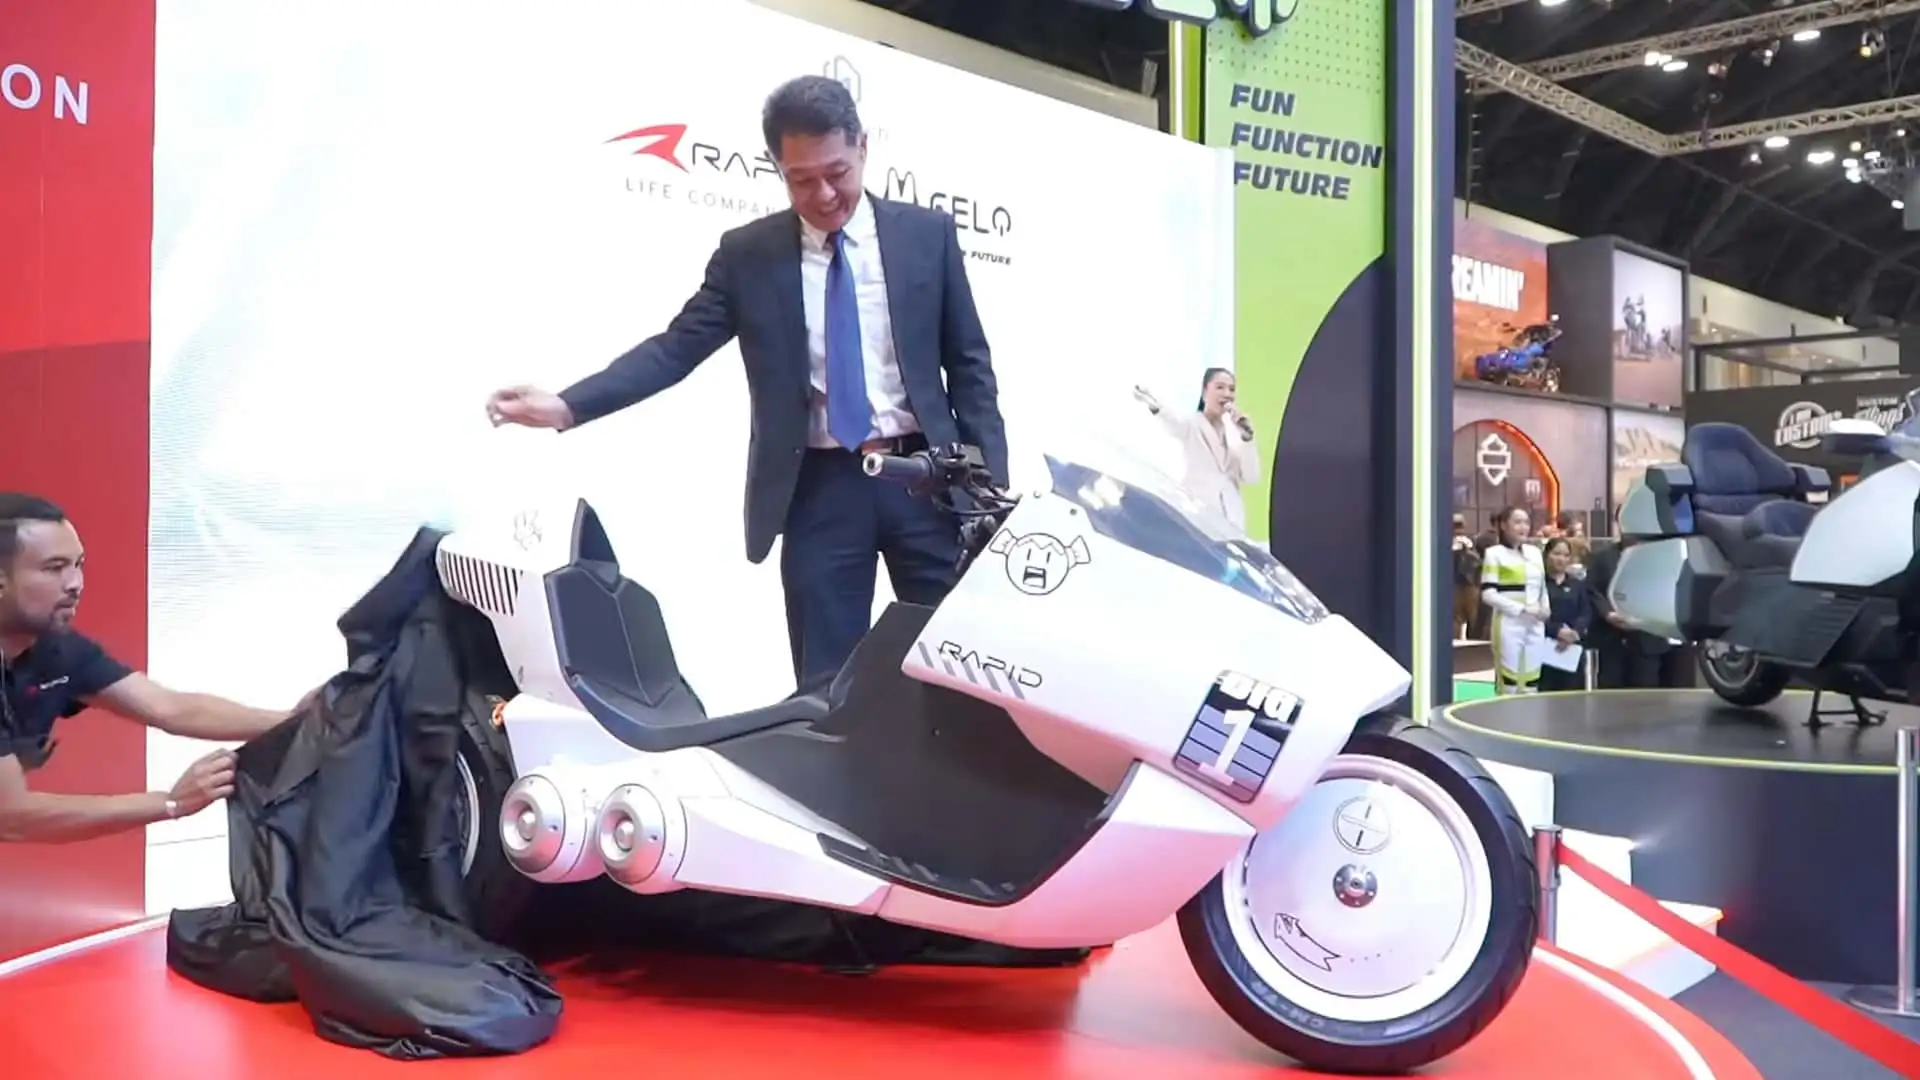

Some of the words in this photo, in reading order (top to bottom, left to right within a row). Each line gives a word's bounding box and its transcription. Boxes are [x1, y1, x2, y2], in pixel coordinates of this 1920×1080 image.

[1230, 84, 1295, 116] FUN
[692, 142, 782, 179] RAP
[1230, 122, 1383, 168] FUNCTION
[626, 176, 672, 199] LIFE
[688, 189, 778, 217] COMPAN
[1233, 161, 1351, 200] FUTURE
[970, 250, 1012, 266] FUTURE
[938, 640, 1043, 688] RAPID
[1197, 708, 1257, 786] 1
